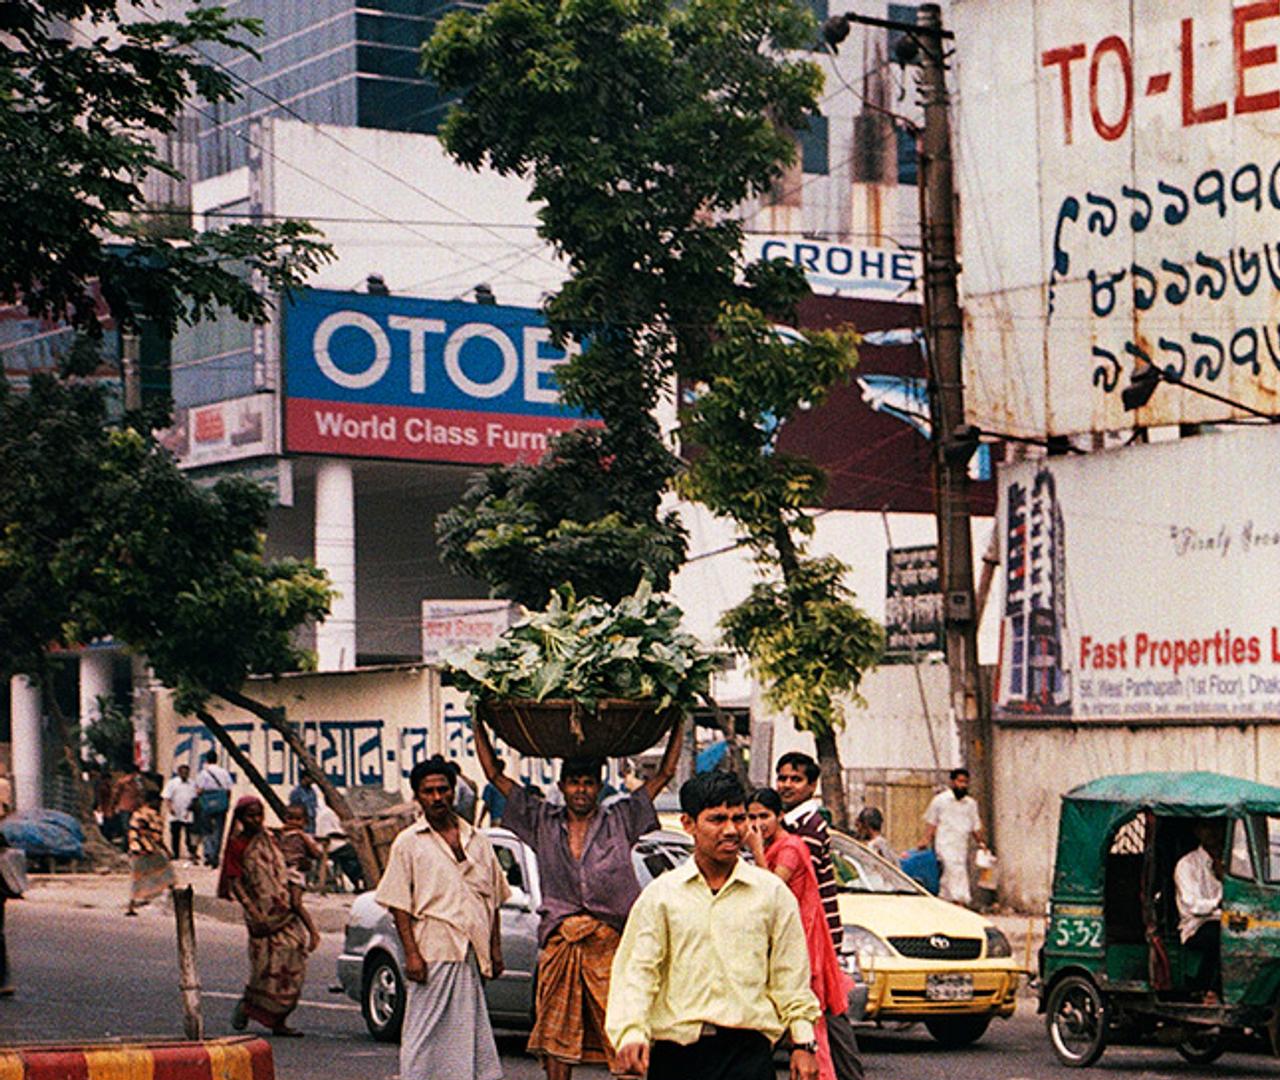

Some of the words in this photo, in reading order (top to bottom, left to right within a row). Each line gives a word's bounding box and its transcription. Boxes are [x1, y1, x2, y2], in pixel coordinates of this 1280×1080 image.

[315, 410, 397, 441] World
[404, 418, 479, 447] Class
[486, 423, 562, 450] Furn
[1080, 635, 1127, 670] Fast
[1135, 628, 1261, 675] Properties
